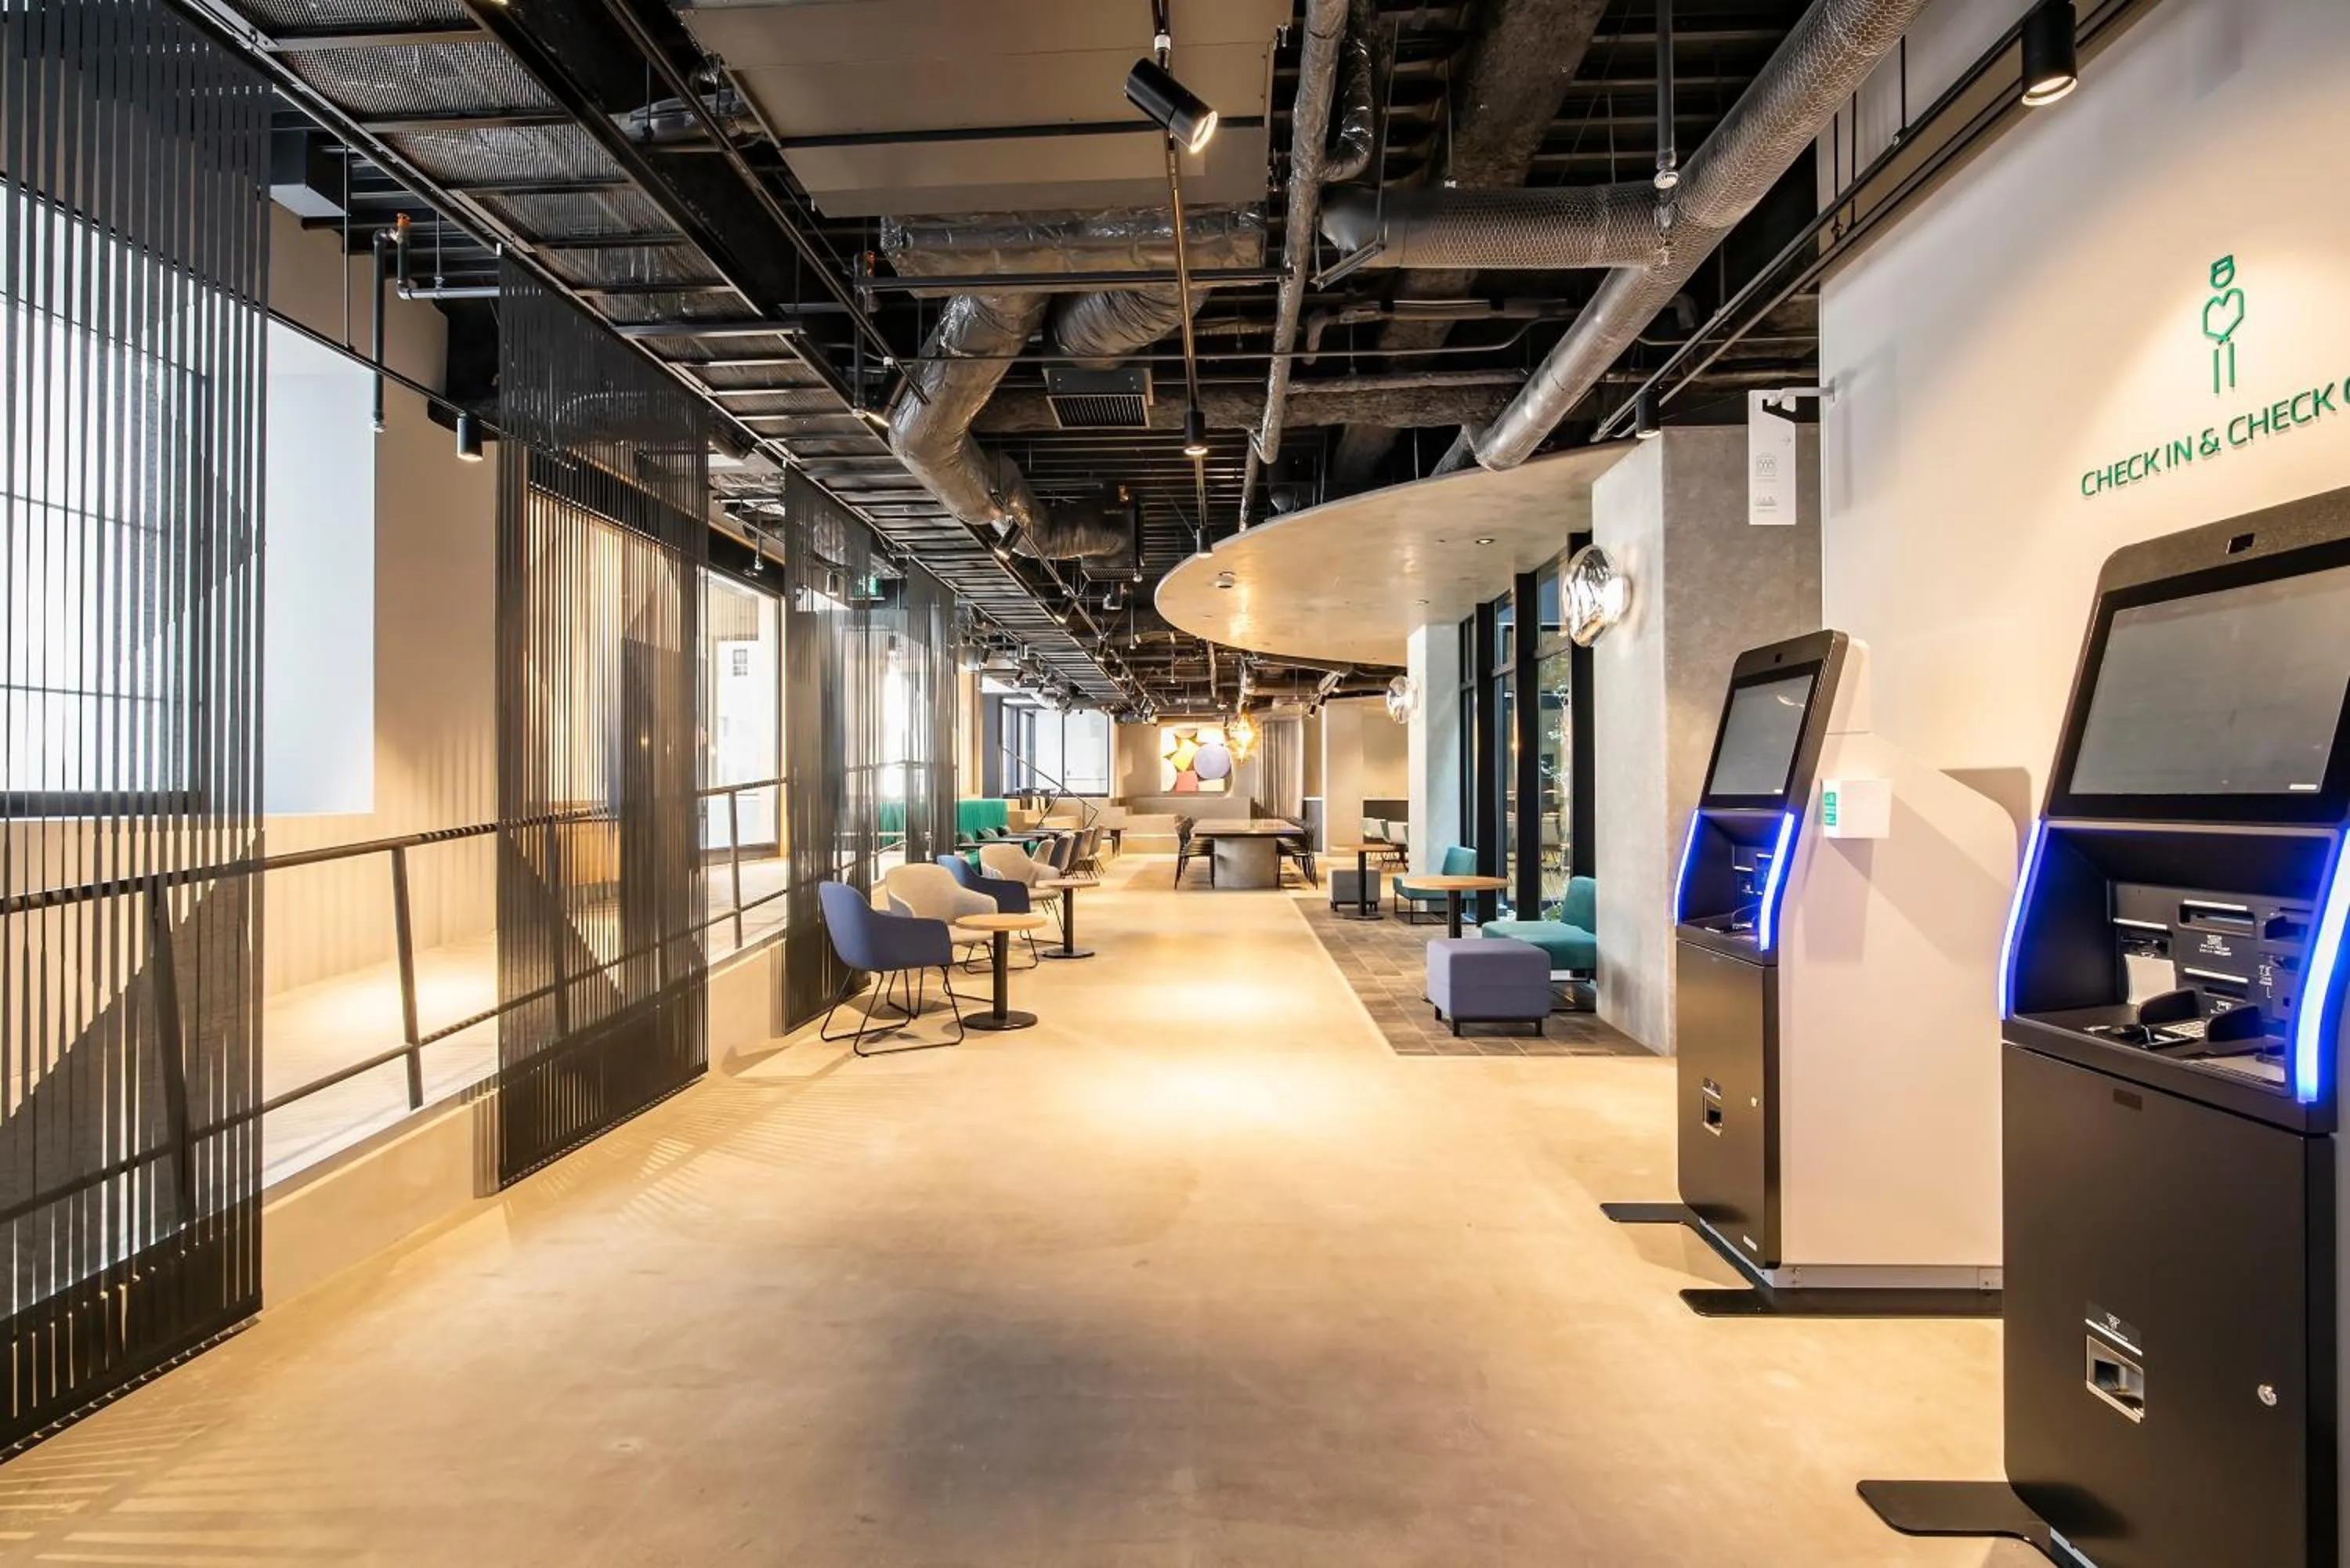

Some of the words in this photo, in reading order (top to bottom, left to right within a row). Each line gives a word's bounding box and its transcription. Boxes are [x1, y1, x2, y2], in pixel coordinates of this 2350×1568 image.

[2081, 447, 2160, 496] CHECK
[2167, 435, 2193, 468] IN
[2199, 428, 2221, 456] &
[2227, 381, 2337, 446] CHECK
